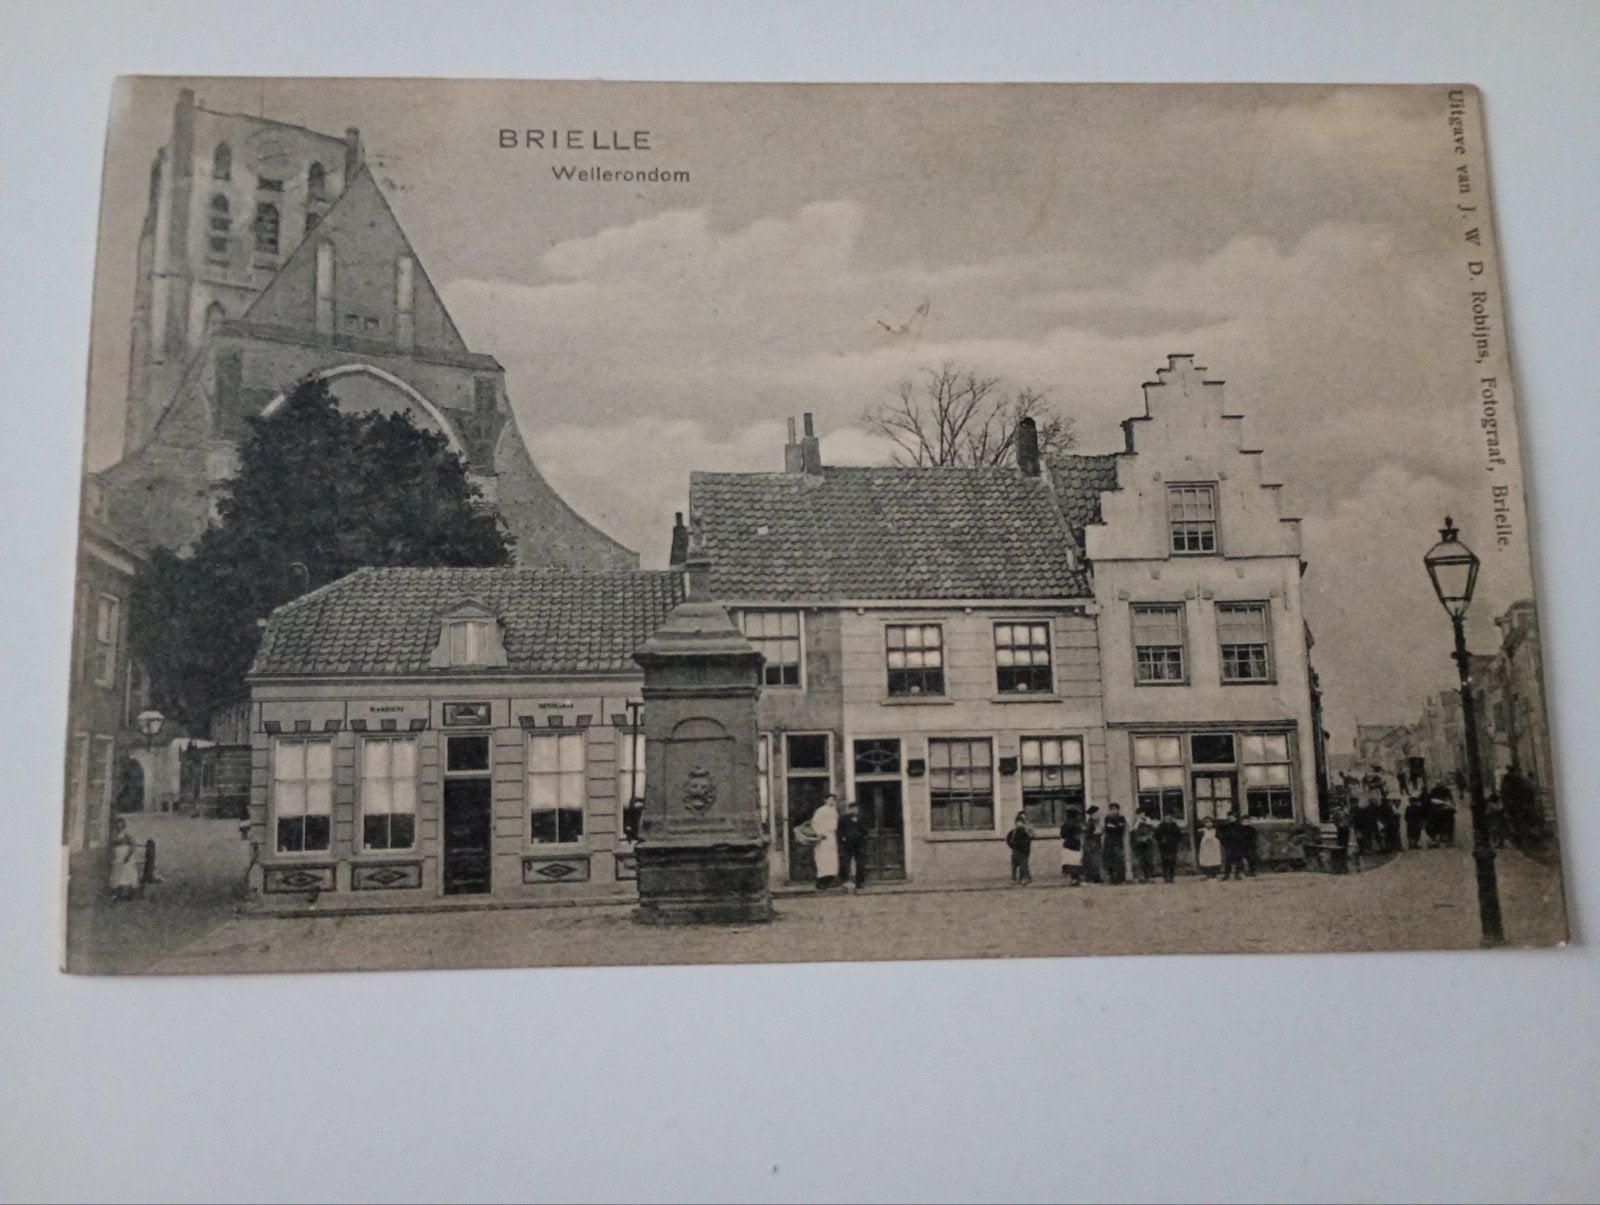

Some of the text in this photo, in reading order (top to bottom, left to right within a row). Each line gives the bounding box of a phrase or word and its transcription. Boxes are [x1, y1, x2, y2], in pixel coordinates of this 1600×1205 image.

[1448, 90, 1467, 156] Uitgave
[499, 129, 651, 151] BRIELLE
[1457, 164, 1471, 194] van
[1467, 261, 1484, 282] D.
[1480, 376, 1506, 472] Fotograaf,
